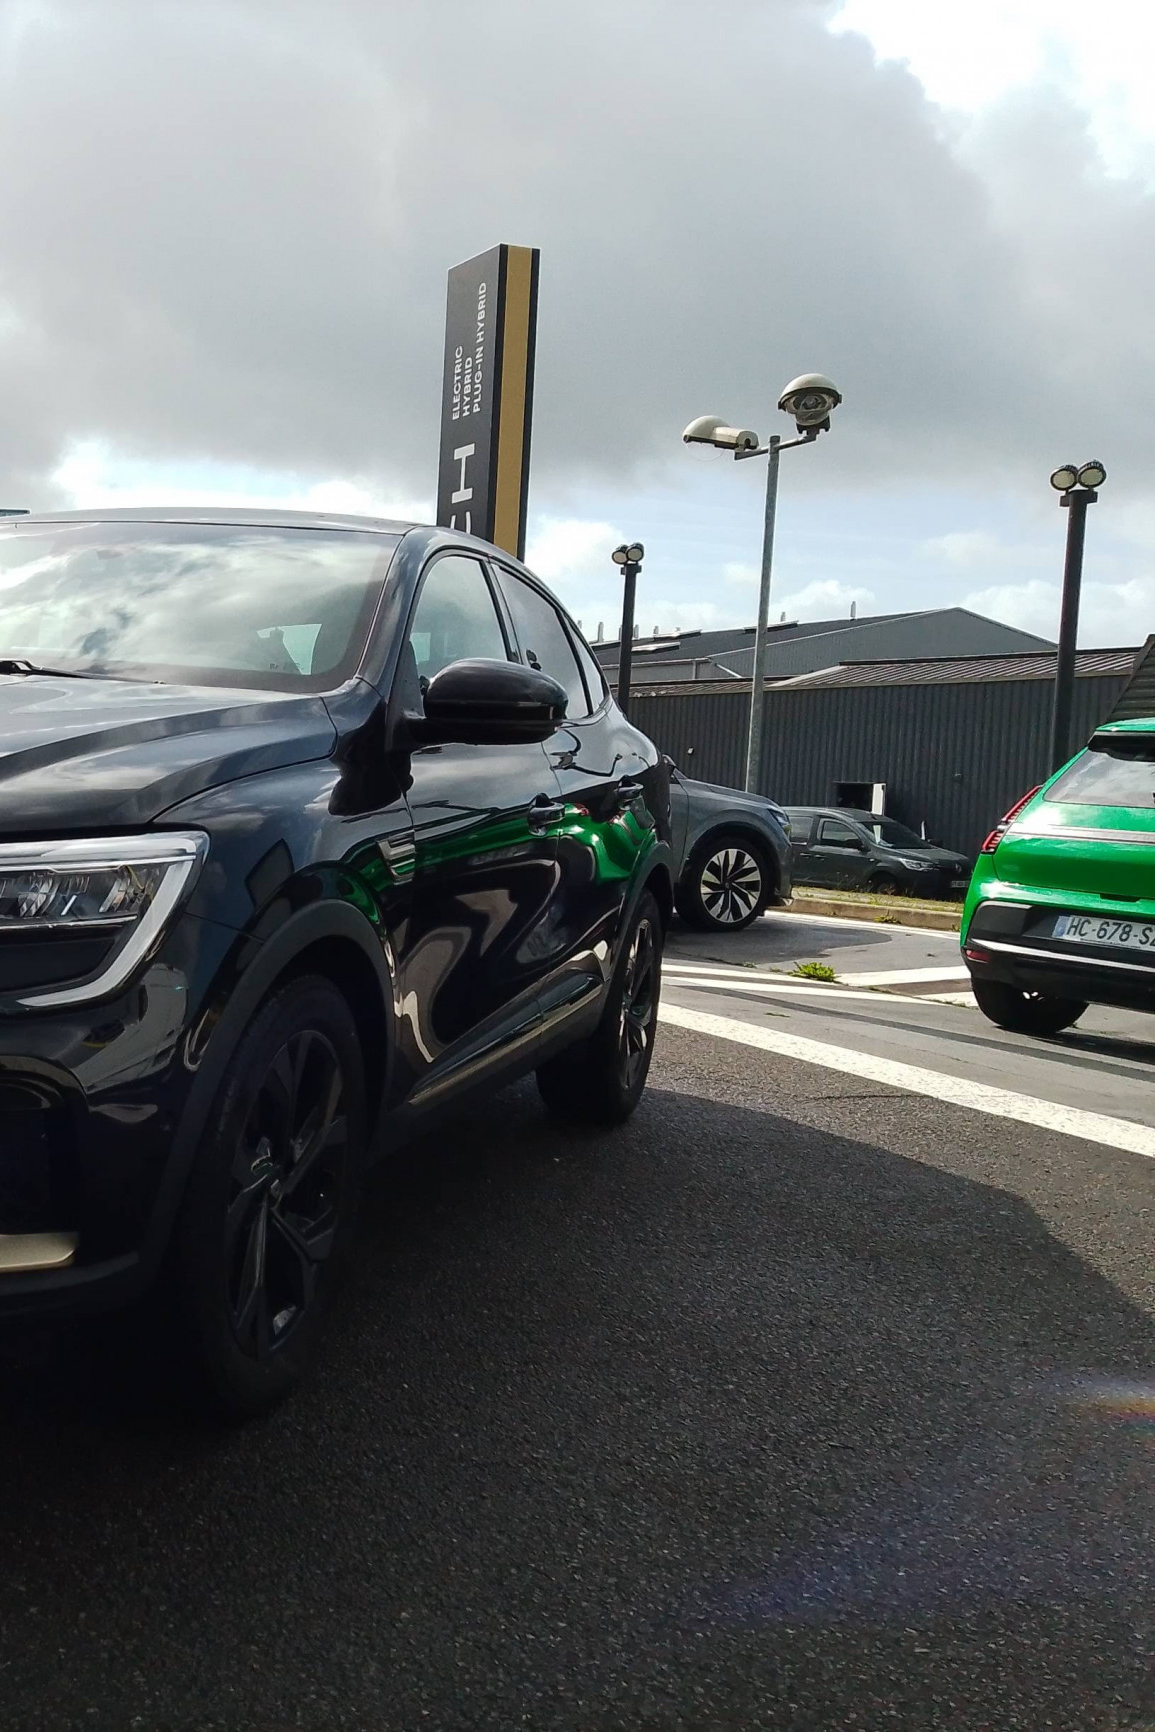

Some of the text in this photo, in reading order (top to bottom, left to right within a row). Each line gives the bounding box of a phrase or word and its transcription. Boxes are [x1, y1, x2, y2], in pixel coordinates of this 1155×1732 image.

[452, 345, 463, 420] ELECTRIC
[473, 282, 487, 413] PLUG-IN HYBRID
[462, 357, 473, 417] HYBRID
